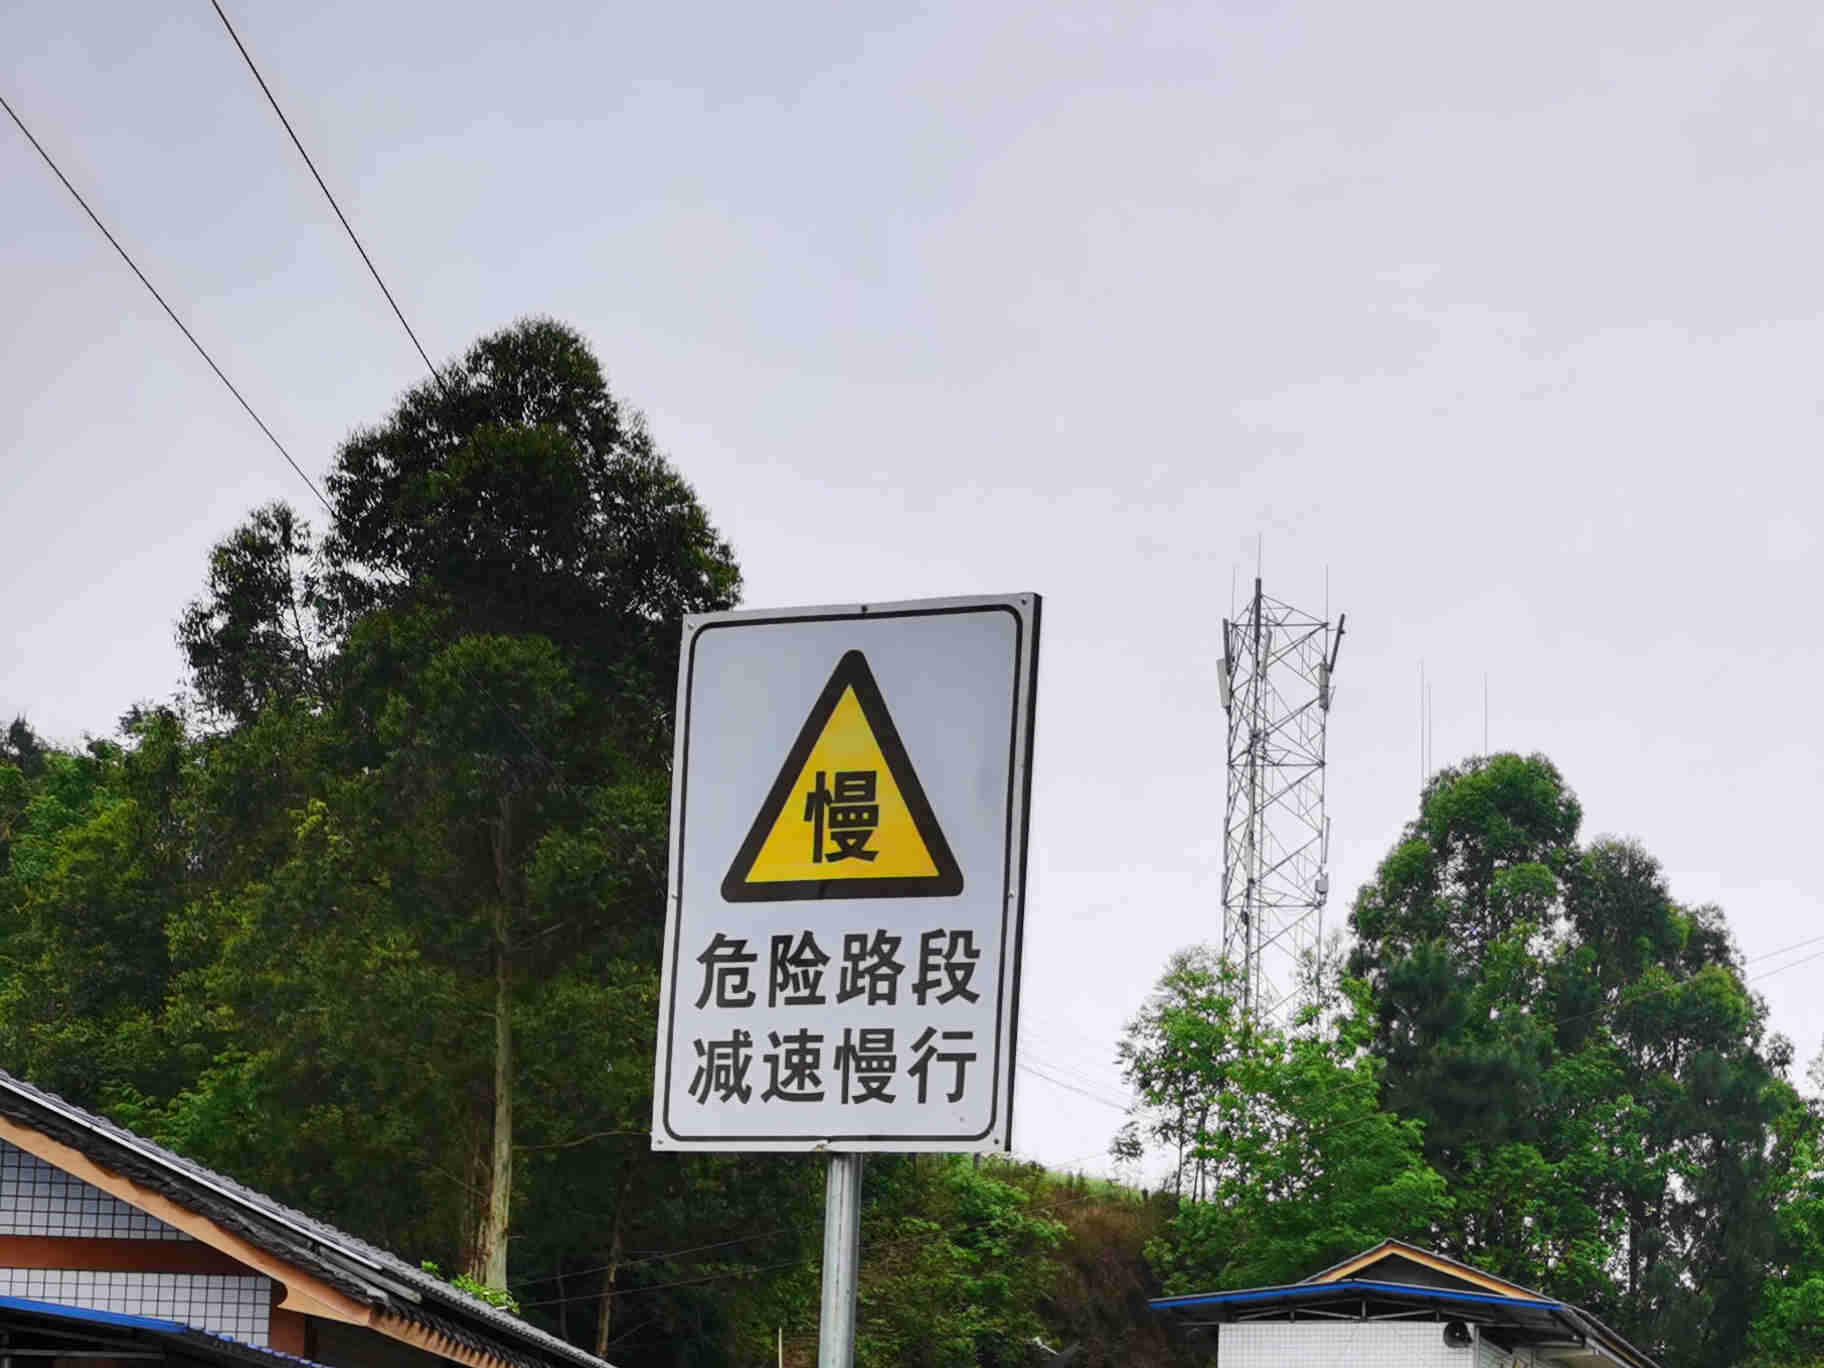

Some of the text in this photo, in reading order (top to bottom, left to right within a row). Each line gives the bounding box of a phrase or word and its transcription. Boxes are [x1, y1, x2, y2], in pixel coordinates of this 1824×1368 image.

[804, 770, 881, 864] 慢
[695, 928, 982, 1010] 危险路段
[688, 1025, 978, 1105] 减速慢行
